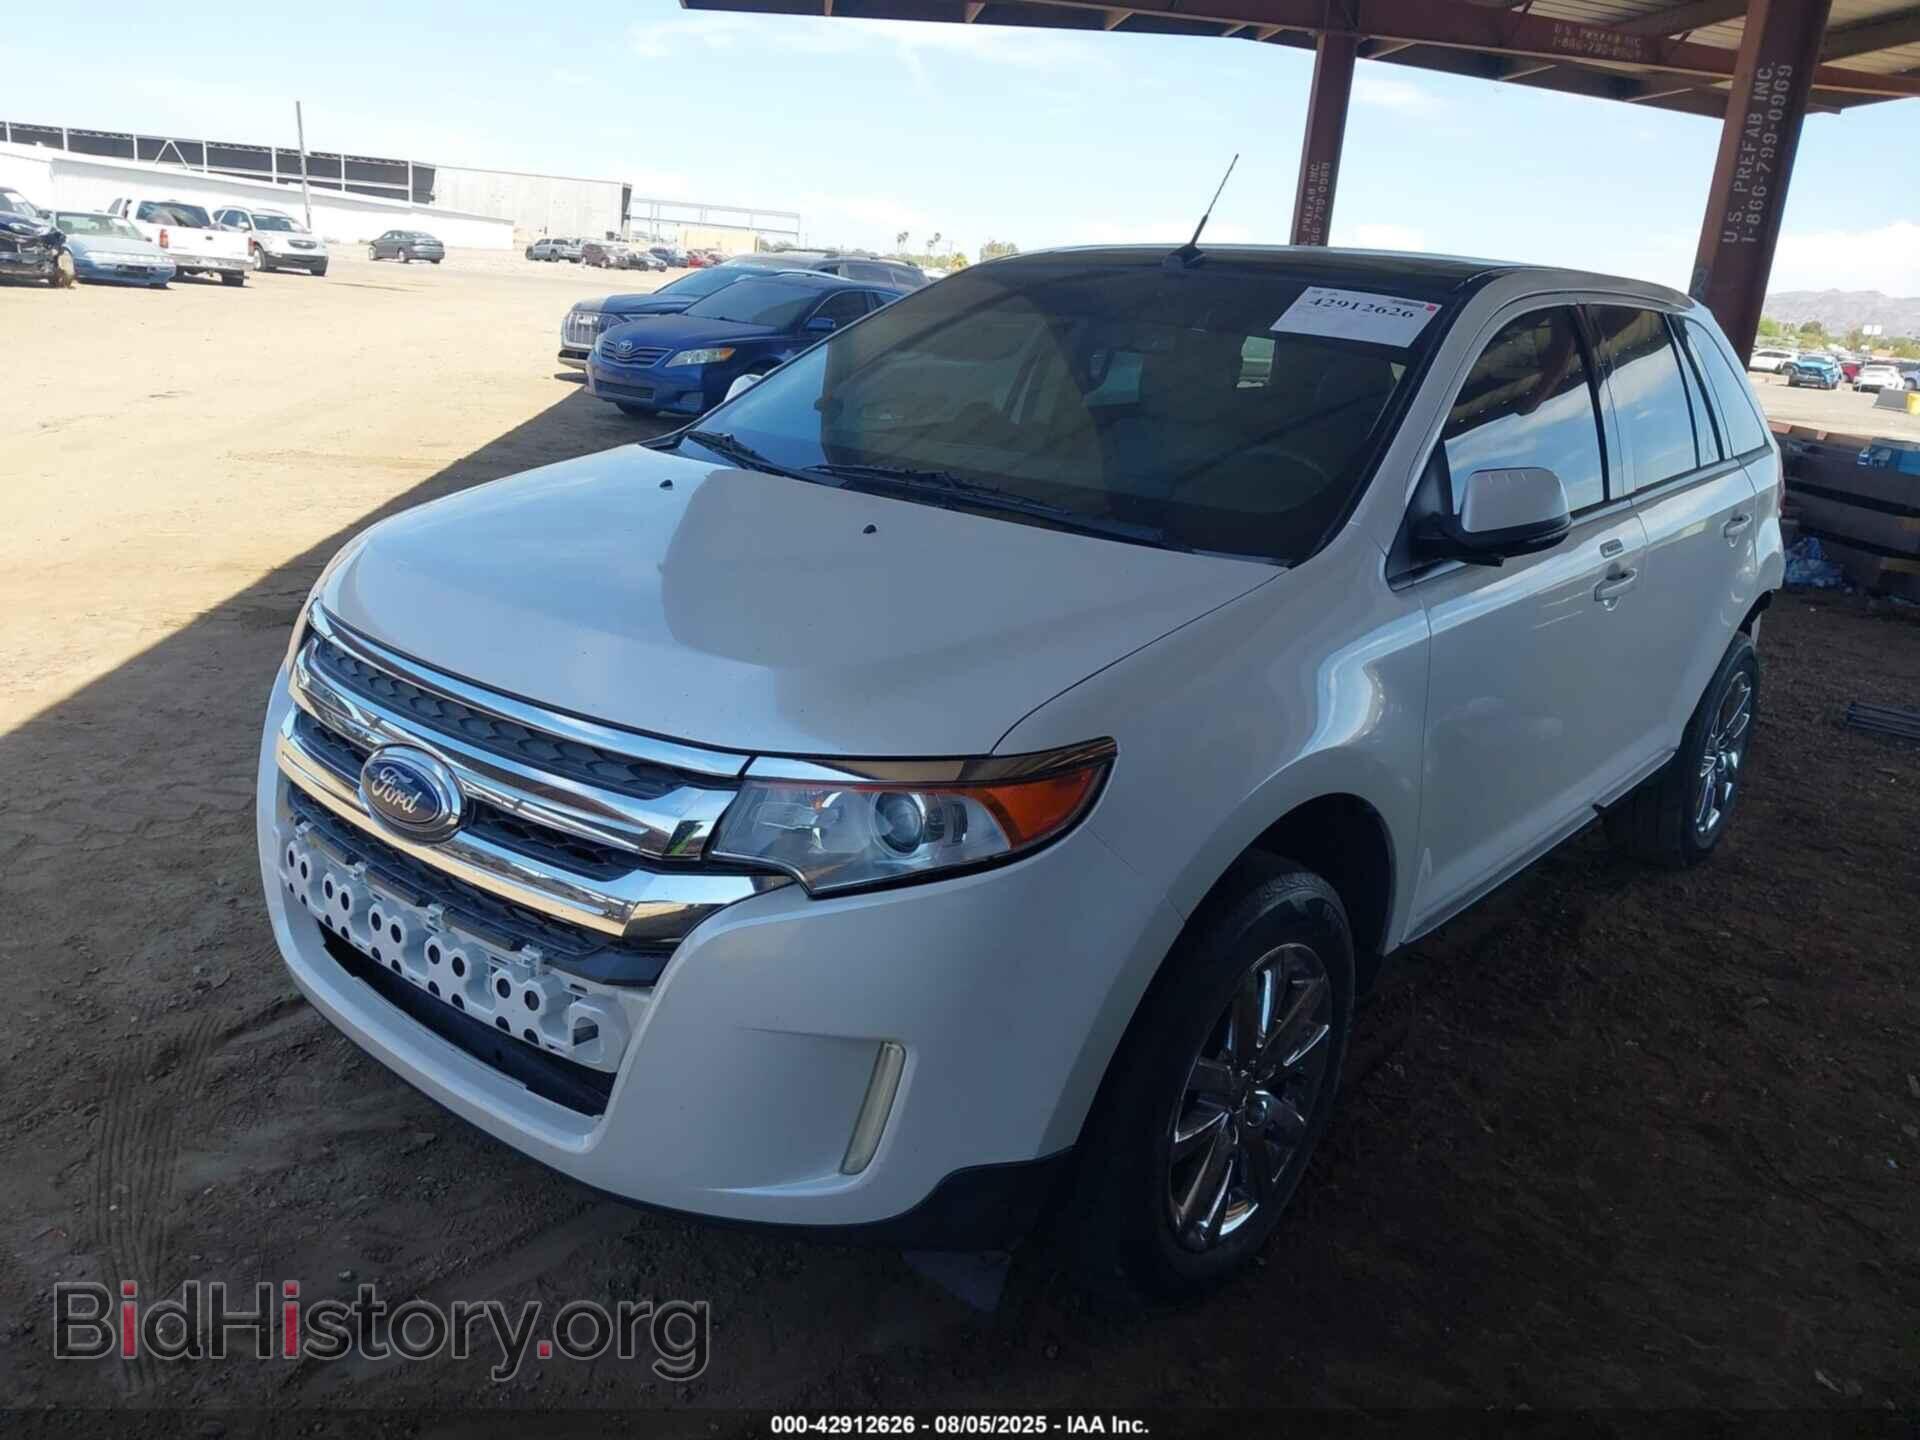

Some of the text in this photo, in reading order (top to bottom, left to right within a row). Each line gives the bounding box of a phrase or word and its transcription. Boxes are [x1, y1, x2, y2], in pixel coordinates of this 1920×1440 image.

[1722, 61, 1775, 243] U.S. PREFAB INC.
[1741, 64, 1793, 243] 1-866-799-0969
[1309, 297, 1415, 318] 42912626
[371, 766, 423, 814] Ford
